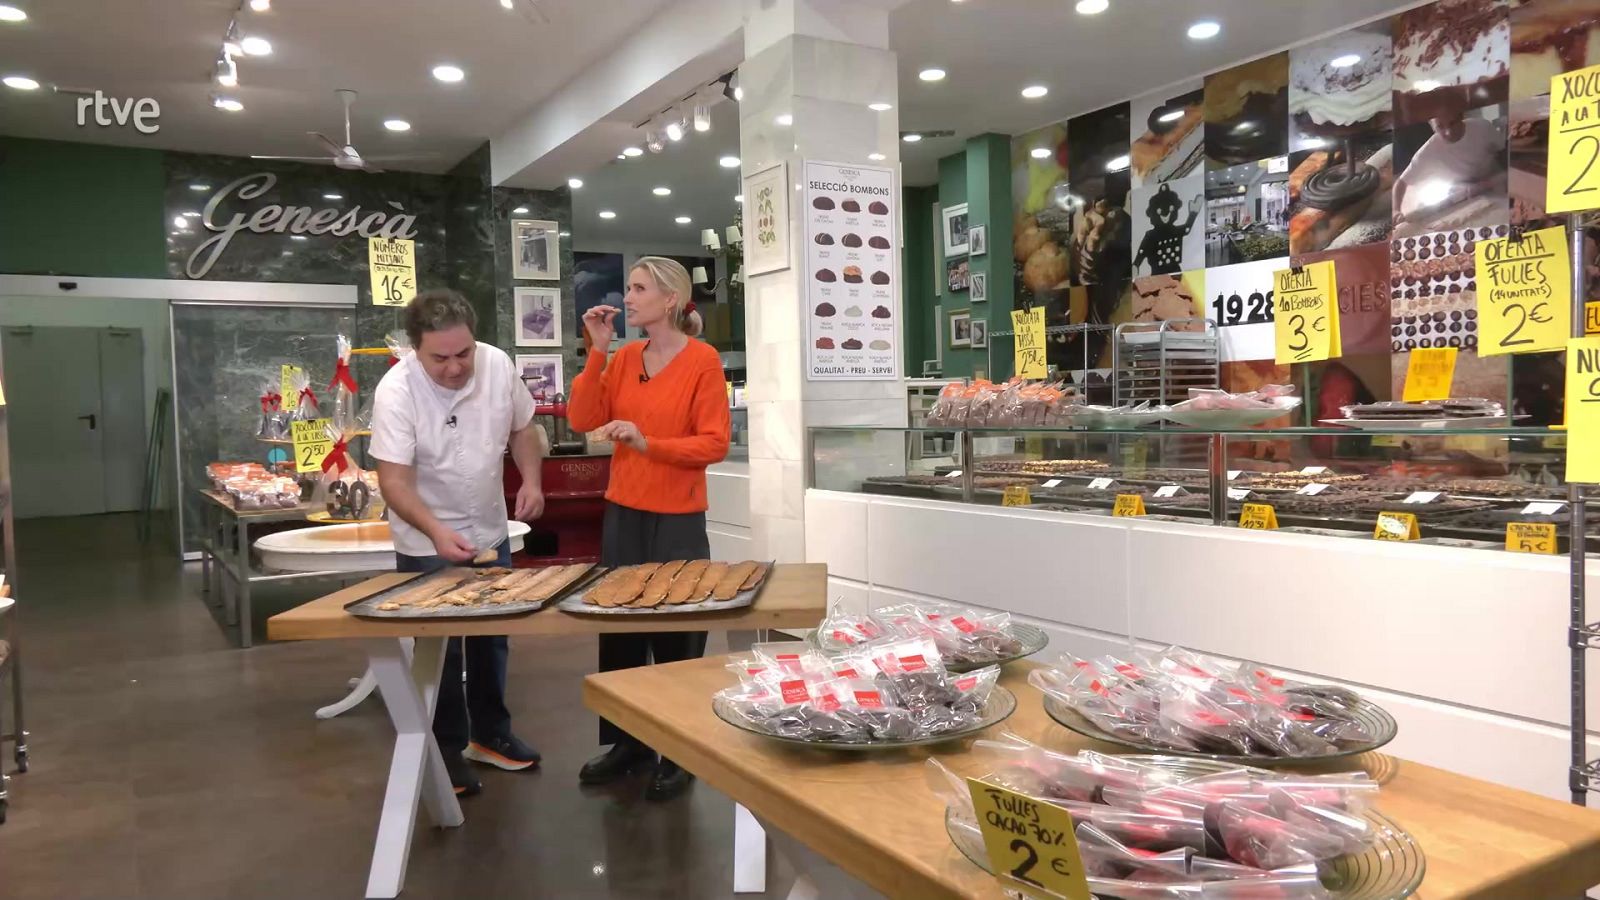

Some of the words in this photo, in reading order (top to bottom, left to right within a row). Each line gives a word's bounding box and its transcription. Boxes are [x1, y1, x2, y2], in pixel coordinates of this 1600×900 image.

[1561, 110, 1570, 127] A
[1575, 106, 1589, 122] LA
[1563, 135, 1600, 196] 2
[809, 181, 848, 192] SELECCIÓ
[850, 185, 889, 196] BOMBONS
[185, 172, 418, 280] Genescà
[1484, 233, 1546, 261] OFERTA
[1280, 268, 1313, 290] OFERTA
[1487, 260, 1547, 286] FULLES
[813, 366, 845, 374] QUALITAT
[984, 788, 1040, 823] FULLES
[986, 811, 1026, 836] CACAO
[1009, 839, 1045, 889] 2
